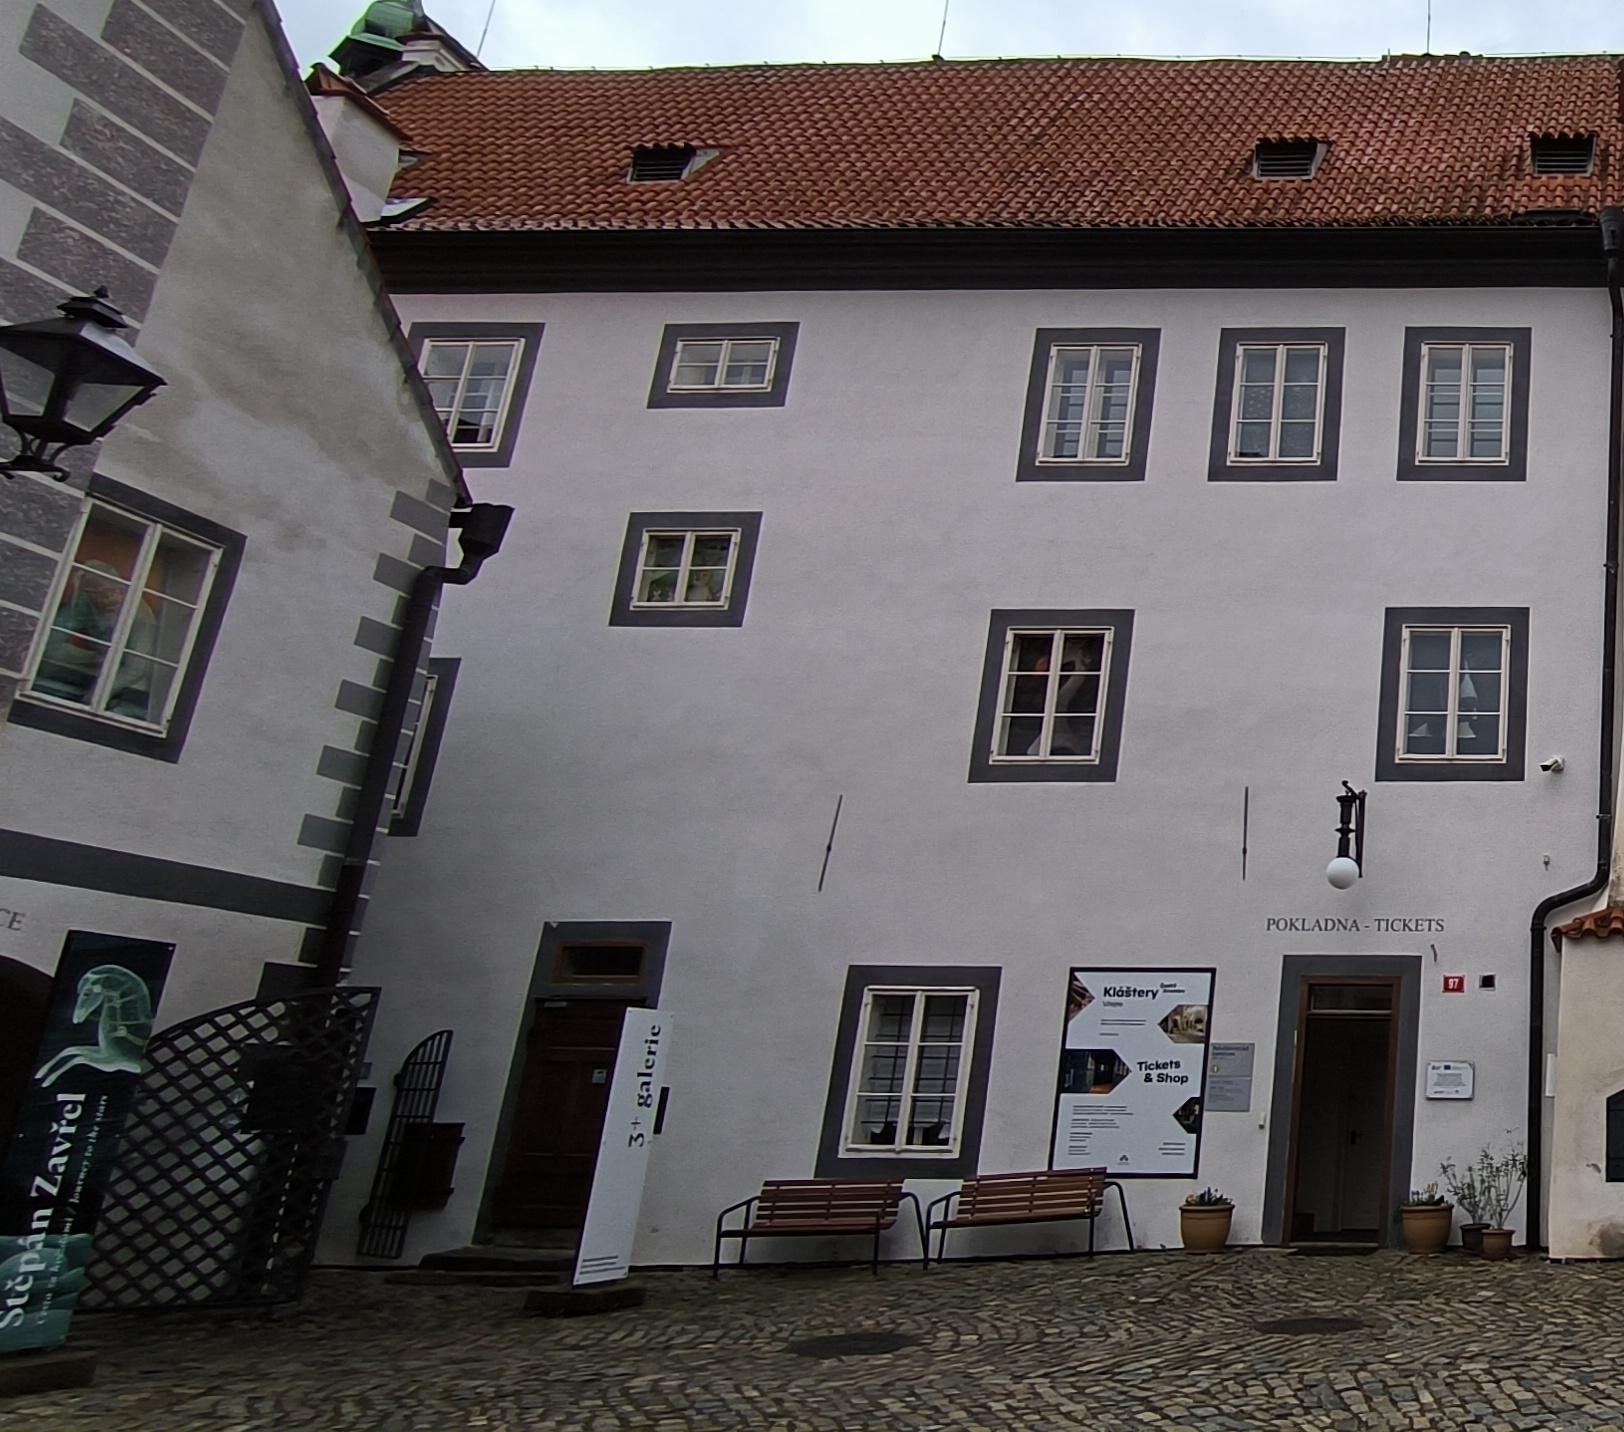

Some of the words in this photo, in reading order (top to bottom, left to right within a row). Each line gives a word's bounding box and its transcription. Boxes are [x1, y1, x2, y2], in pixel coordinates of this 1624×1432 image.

[1265, 918, 1360, 932] POKLADNA
[1374, 918, 1445, 932] TICKETS
[1448, 978, 1459, 990] 97
[1103, 985, 1159, 1000] Kláštery
[637, 1024, 662, 1108] galerie
[1137, 1061, 1181, 1071] Tickets
[1144, 1073, 1153, 1083] &
[1157, 1073, 1189, 1085] Shop
[30, 1093, 86, 1197] Zavřel
